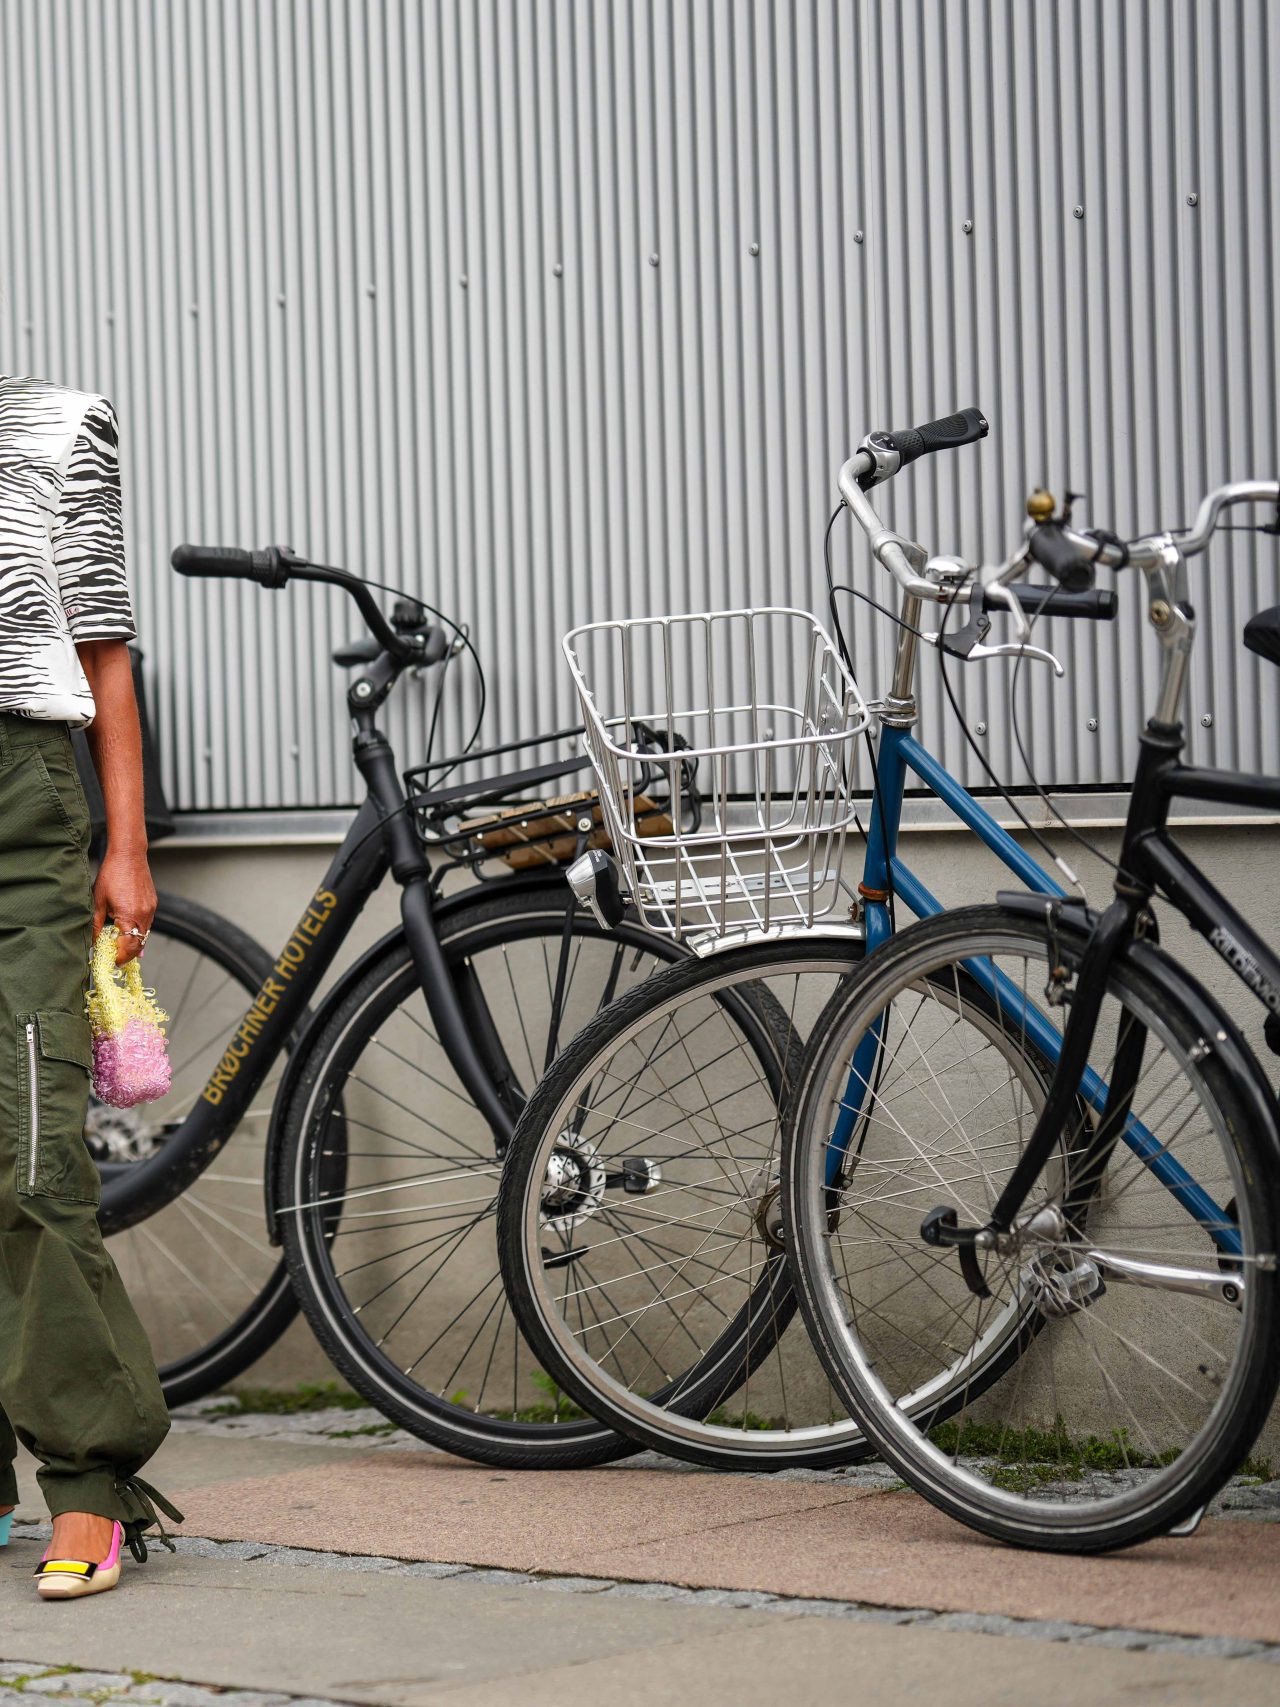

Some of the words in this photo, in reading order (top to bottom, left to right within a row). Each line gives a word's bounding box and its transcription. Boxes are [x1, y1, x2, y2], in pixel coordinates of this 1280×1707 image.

[202, 977, 286, 1105] BRØCHNER
[274, 887, 338, 981] HOTELS
[1209, 928, 1280, 1014] KILDEMO
